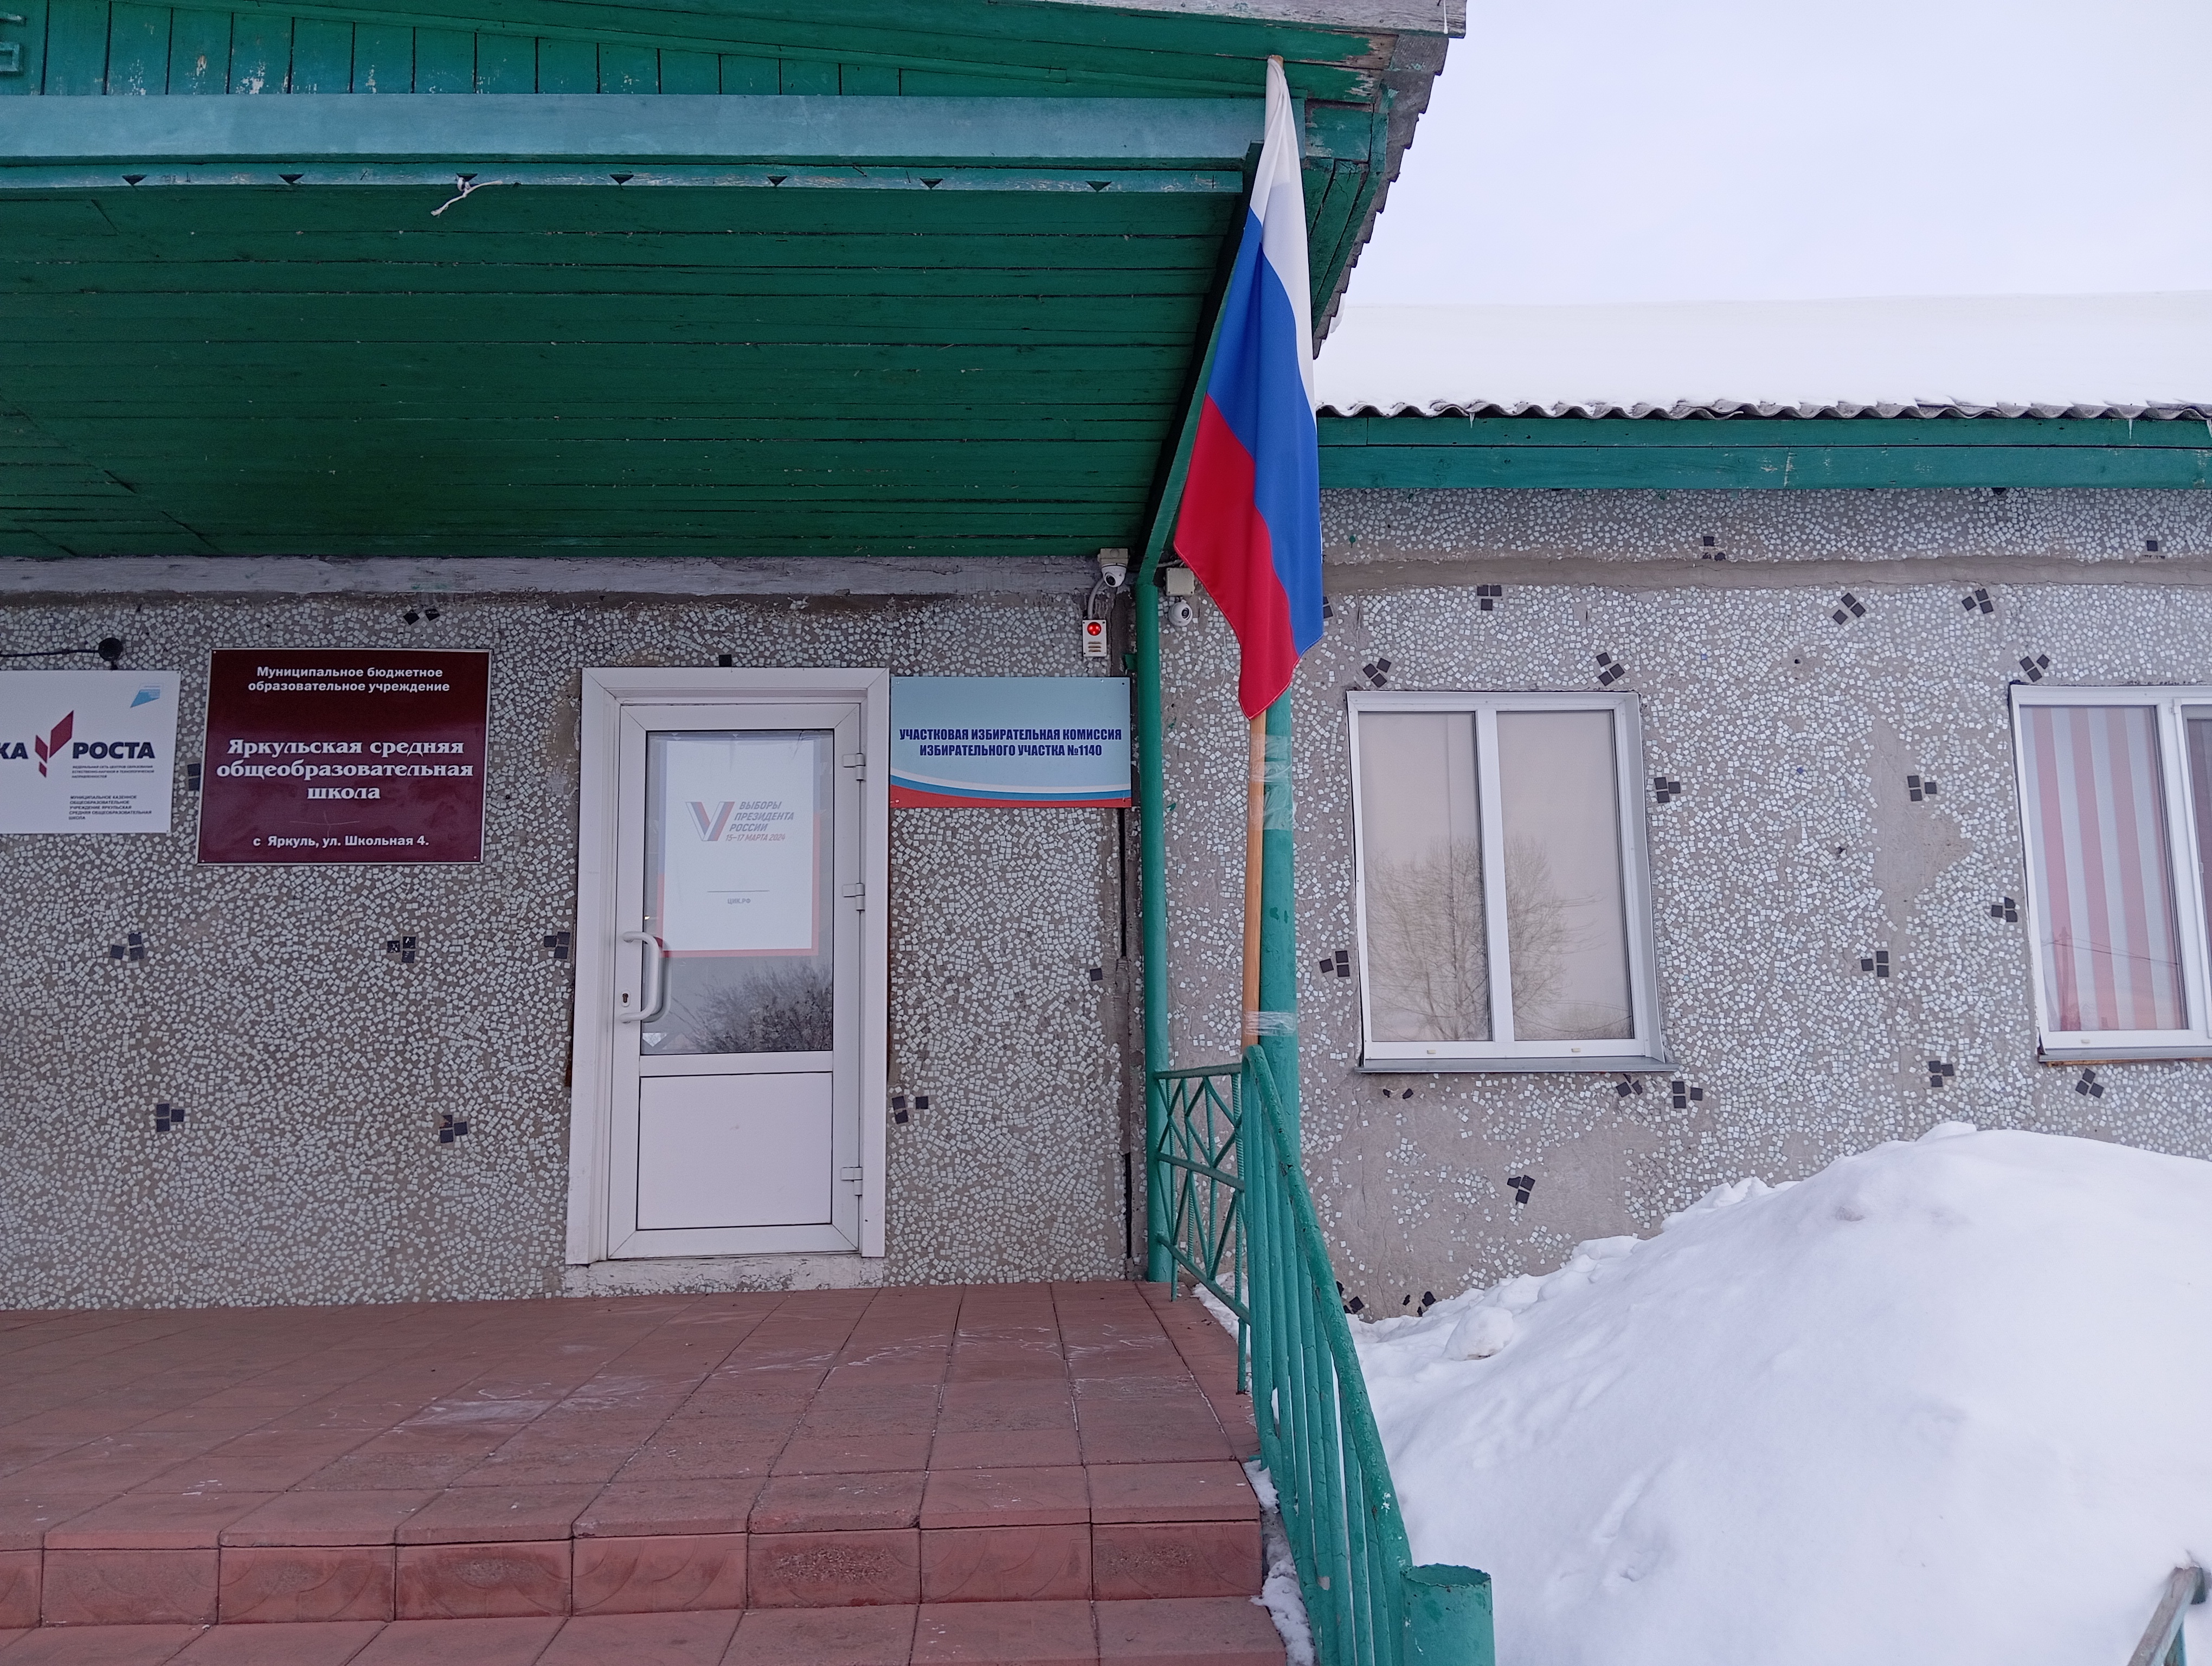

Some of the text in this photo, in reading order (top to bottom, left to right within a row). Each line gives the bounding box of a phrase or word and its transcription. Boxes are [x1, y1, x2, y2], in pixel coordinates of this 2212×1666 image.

[256, 666, 443, 679] Муниципальное бюджетное
[248, 681, 450, 693] образовательное учреждение
[899, 729, 1122, 740] УЧАСТКОВАЯ ИЗБИРАТЕЛЬНАЯ КОМИССИЯ
[72, 742, 155, 759] РОСТА
[227, 739, 464, 758] Яркульская средняя
[919, 745, 1102, 757] ИЗБИРАТЕЛЬНОГО УЧАСТКА №1140
[216, 759, 473, 780] общеобразовательная
[307, 787, 381, 799] школа
[739, 801, 782, 810] ВЫБОРЫ
[734, 812, 794, 822] ПРЕЗИДЕНТА
[729, 823, 768, 832] РОССИИ
[267, 836, 319, 848] Яркуль,
[322, 837, 341, 848] ул.
[344, 836, 413, 846] Школьная
[416, 836, 429, 845] 4.
